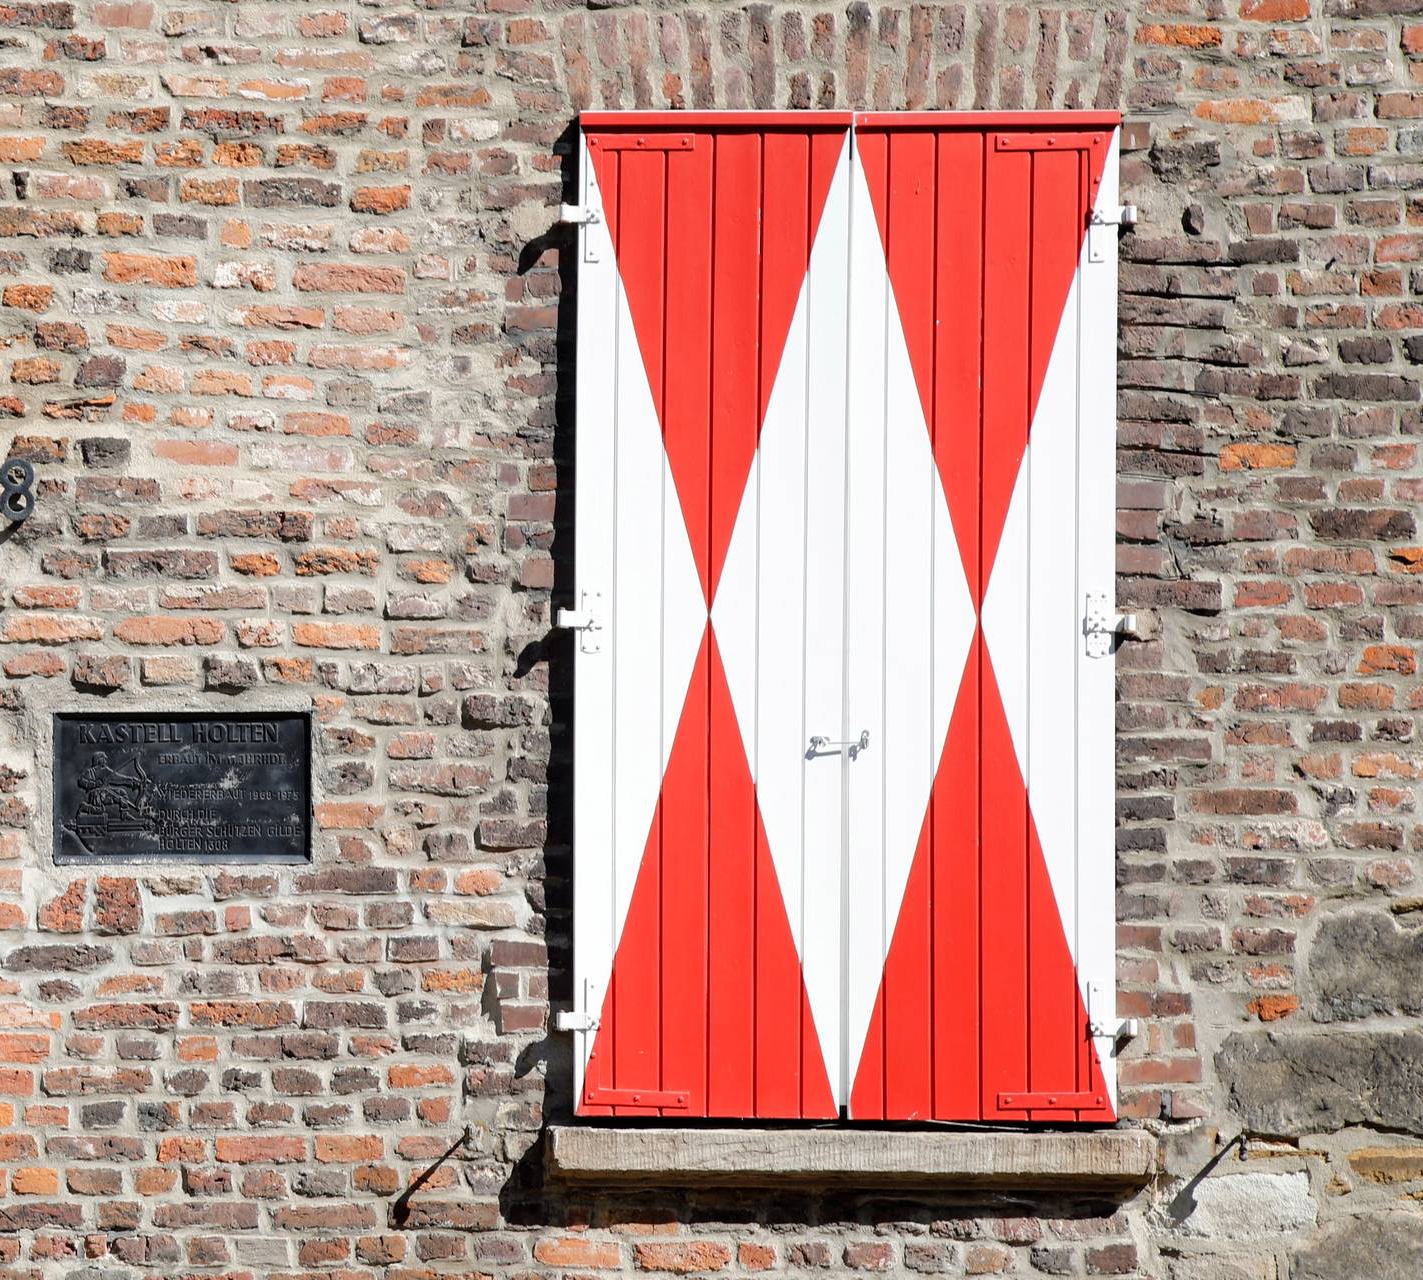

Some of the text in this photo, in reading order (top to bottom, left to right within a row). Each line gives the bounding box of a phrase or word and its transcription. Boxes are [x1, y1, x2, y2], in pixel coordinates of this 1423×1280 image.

[79, 722, 279, 744] KASTELL HOLTEN
[158, 753, 202, 764] ERBAUT
[156, 789, 246, 801] WIEDERERBAUT
[158, 808, 217, 820] DURCH DIE
[267, 825, 301, 837] GILDE
[158, 838, 201, 851] HOLTEN
